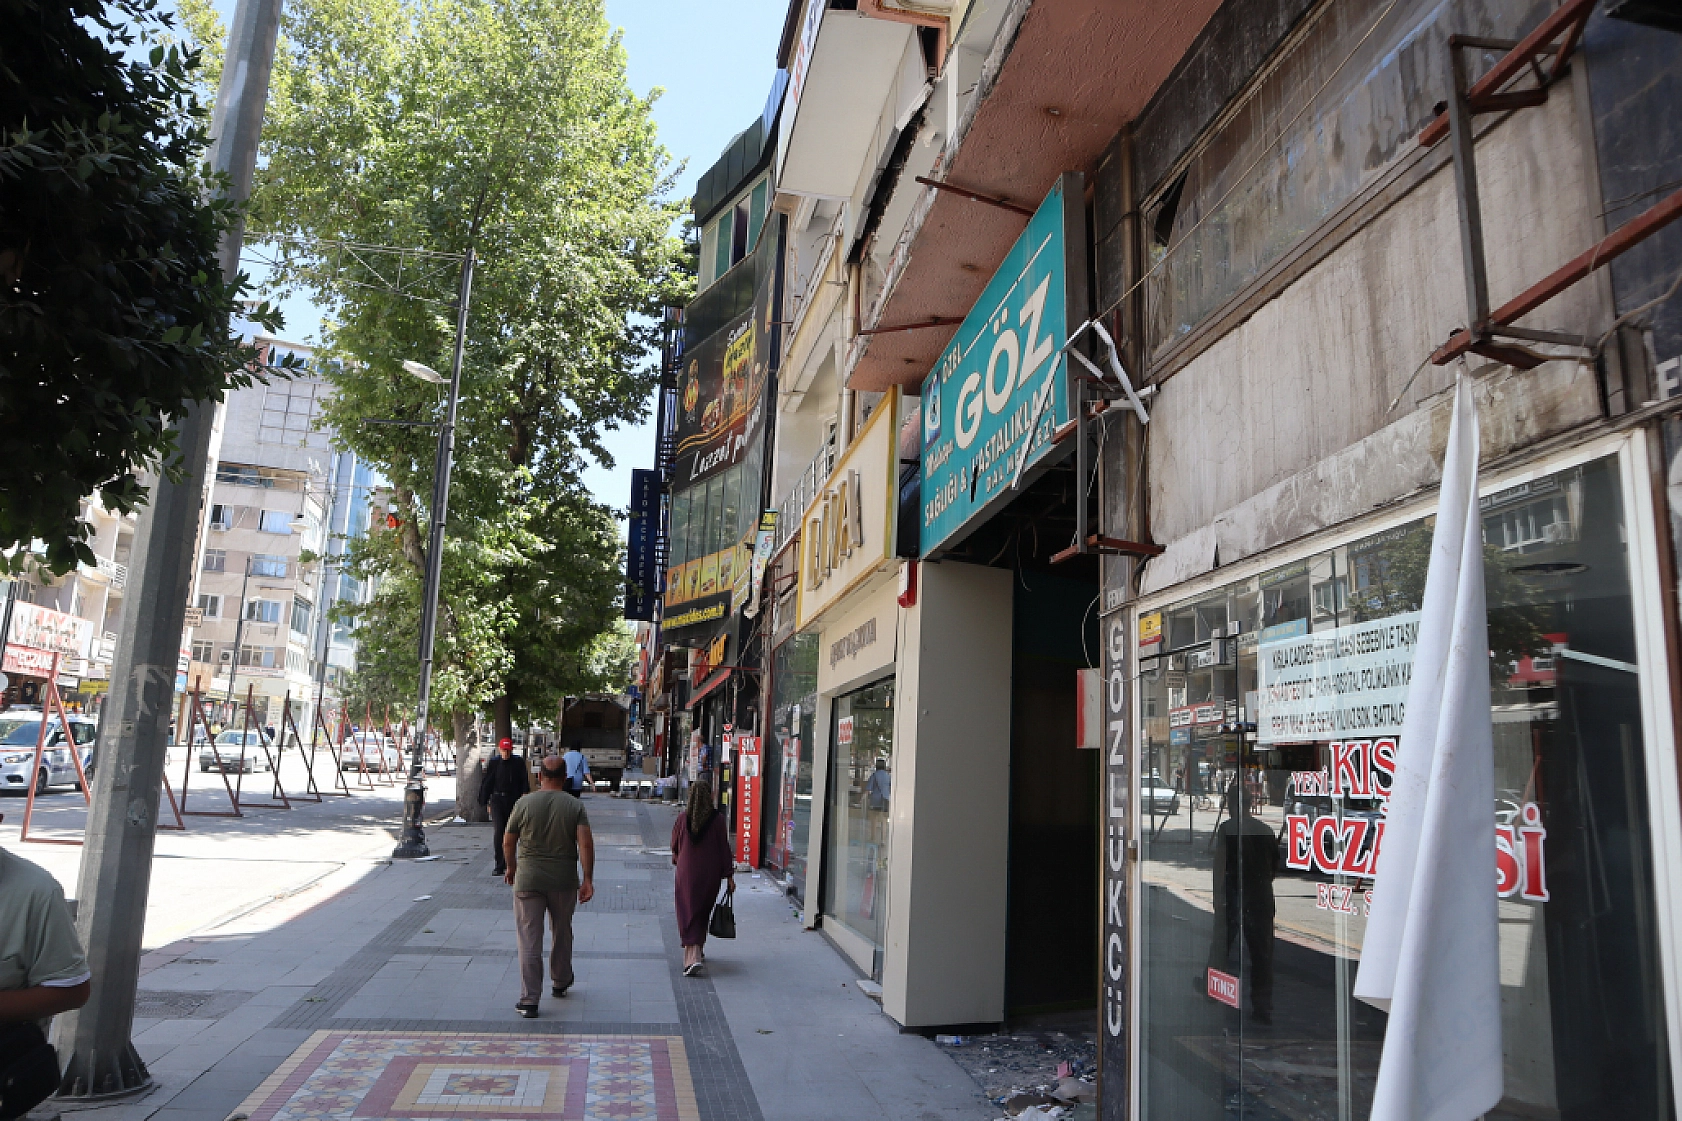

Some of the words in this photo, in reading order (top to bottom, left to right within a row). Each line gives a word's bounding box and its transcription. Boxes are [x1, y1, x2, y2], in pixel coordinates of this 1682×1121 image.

[942, 342, 962, 385] ÖZEL
[954, 270, 1053, 450] GÖZ
[1006, 410, 1056, 474] MEEZİ
[1291, 765, 1329, 797] YENİ
[1316, 883, 1358, 916] ECZ.
